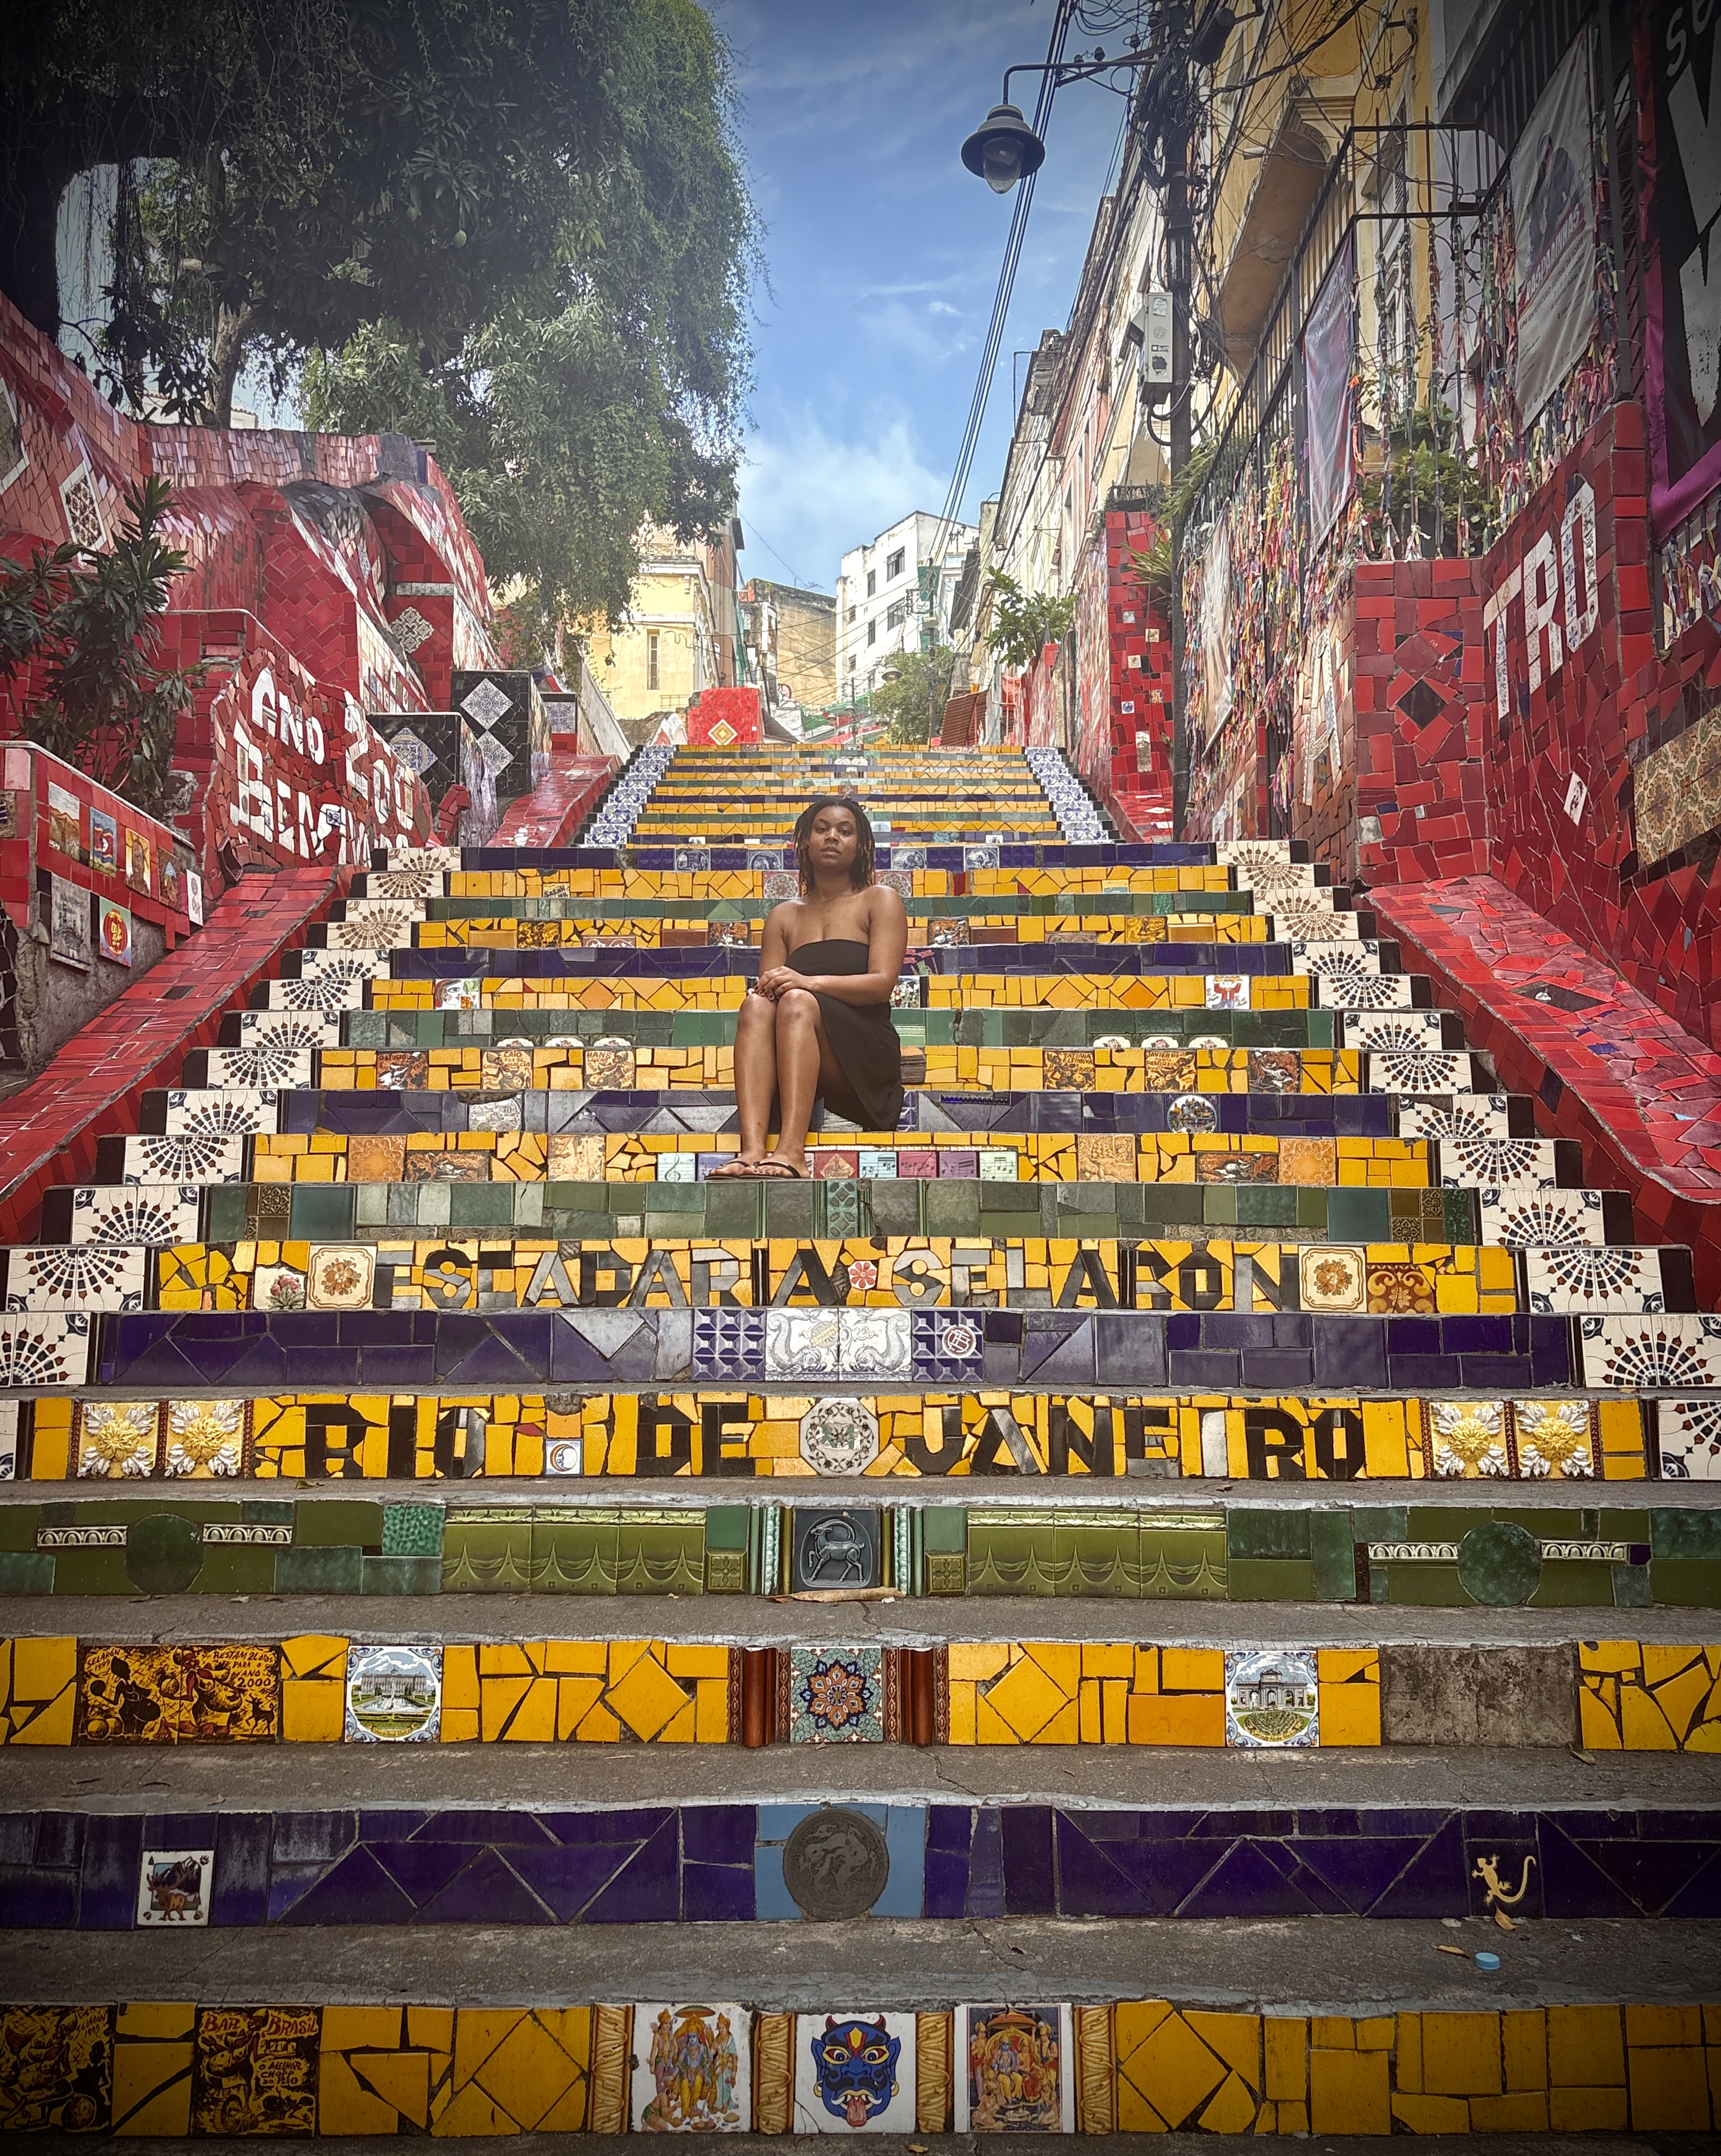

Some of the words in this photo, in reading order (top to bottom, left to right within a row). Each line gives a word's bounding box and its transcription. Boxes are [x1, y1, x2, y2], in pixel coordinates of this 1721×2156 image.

[1525, 203, 1581, 303] RASPADINHAS
[587, 1051, 611, 1059] HANS
[373, 1248, 836, 1309] ESCADARIA
[893, 1248, 1299, 1312] SELARON
[305, 1403, 485, 1478] RIO
[636, 1403, 754, 1477] DE
[905, 1403, 1365, 1480] JANEIRO
[213, 1651, 248, 1660] RESTAM
[95, 1658, 111, 1671] 1999
[241, 1669, 260, 1677] ANO
[237, 1677, 271, 1687] 2000
[201, 2013, 240, 2034] BAR
[268, 2061, 302, 2070] MELHOR
[260, 2070, 295, 2078] CHOPP
